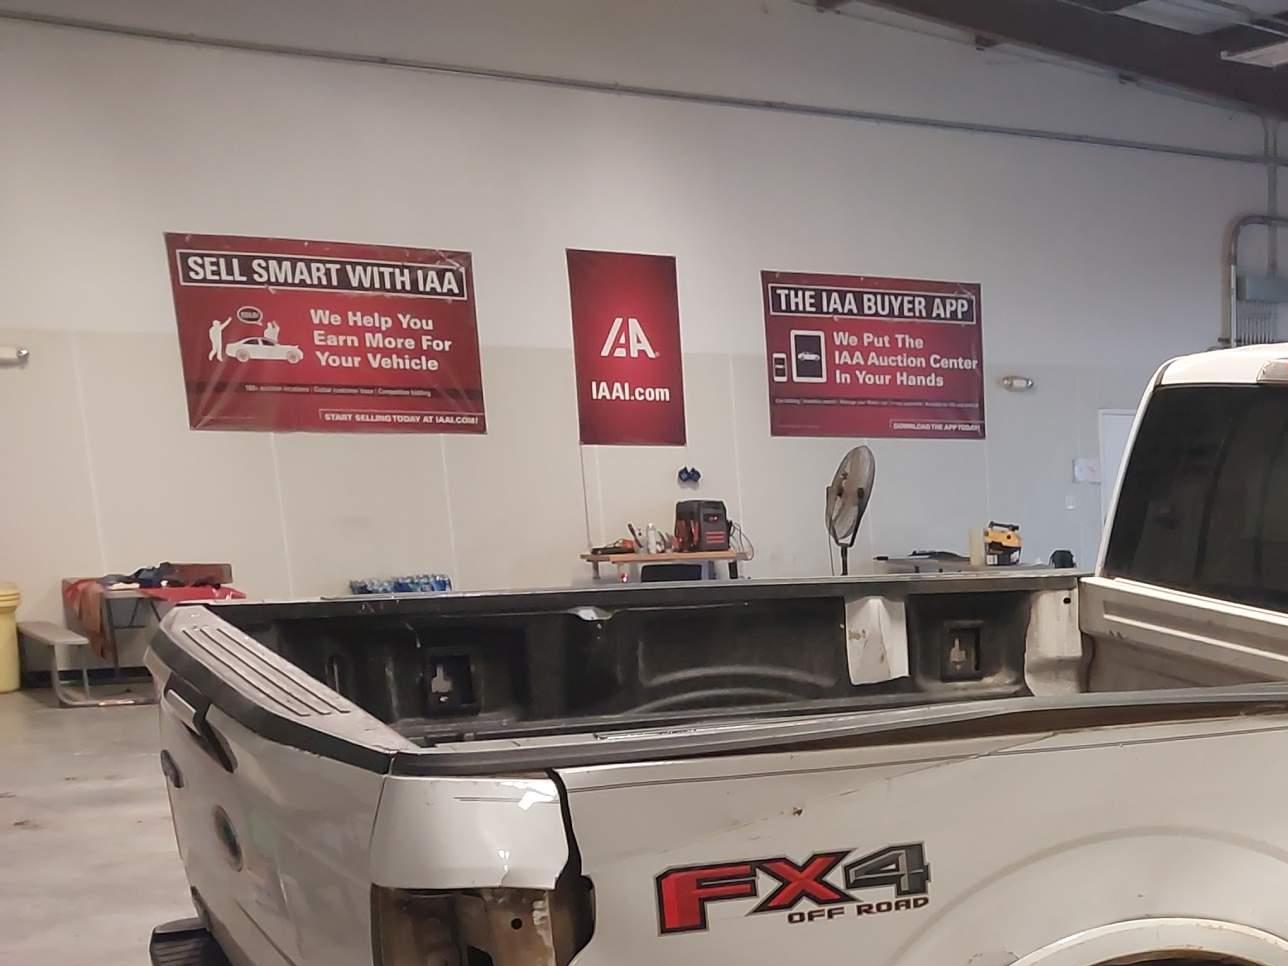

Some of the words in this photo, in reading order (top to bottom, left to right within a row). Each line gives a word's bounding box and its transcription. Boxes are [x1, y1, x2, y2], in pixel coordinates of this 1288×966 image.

[187, 256, 247, 281] SELL
[252, 259, 341, 286] SMART
[345, 264, 411, 291] WITH
[417, 269, 459, 294] IAA
[776, 289, 816, 312] THE
[822, 291, 858, 315] IAA
[863, 294, 926, 317] BUYER
[932, 297, 968, 319] APP
[310, 309, 341, 325] We
[348, 311, 393, 331] Help
[397, 313, 434, 330] You
[313, 330, 359, 347] Earn
[365, 332, 415, 349] More
[421, 335, 452, 351] For
[833, 331, 858, 346] We
[863, 333, 890, 348] Put
[895, 334, 924, 349] The
[315, 351, 361, 368] Your
[367, 353, 439, 371] Vehicle
[834, 350, 865, 365] IAA
[867, 351, 926, 368] Auction
[930, 354, 978, 370] Center
[835, 369, 851, 384] In
[856, 370, 891, 386] Your
[896, 371, 944, 387] Hands
[591, 380, 670, 402] IAAI.com
[324, 413, 353, 421] START
[355, 413, 392, 423] SELLING
[393, 414, 420, 424] TODAY
[423, 415, 434, 424] AT
[656, 842, 931, 934] FX4
[787, 906, 845, 925] OFF
[856, 896, 929, 917] ROAD
